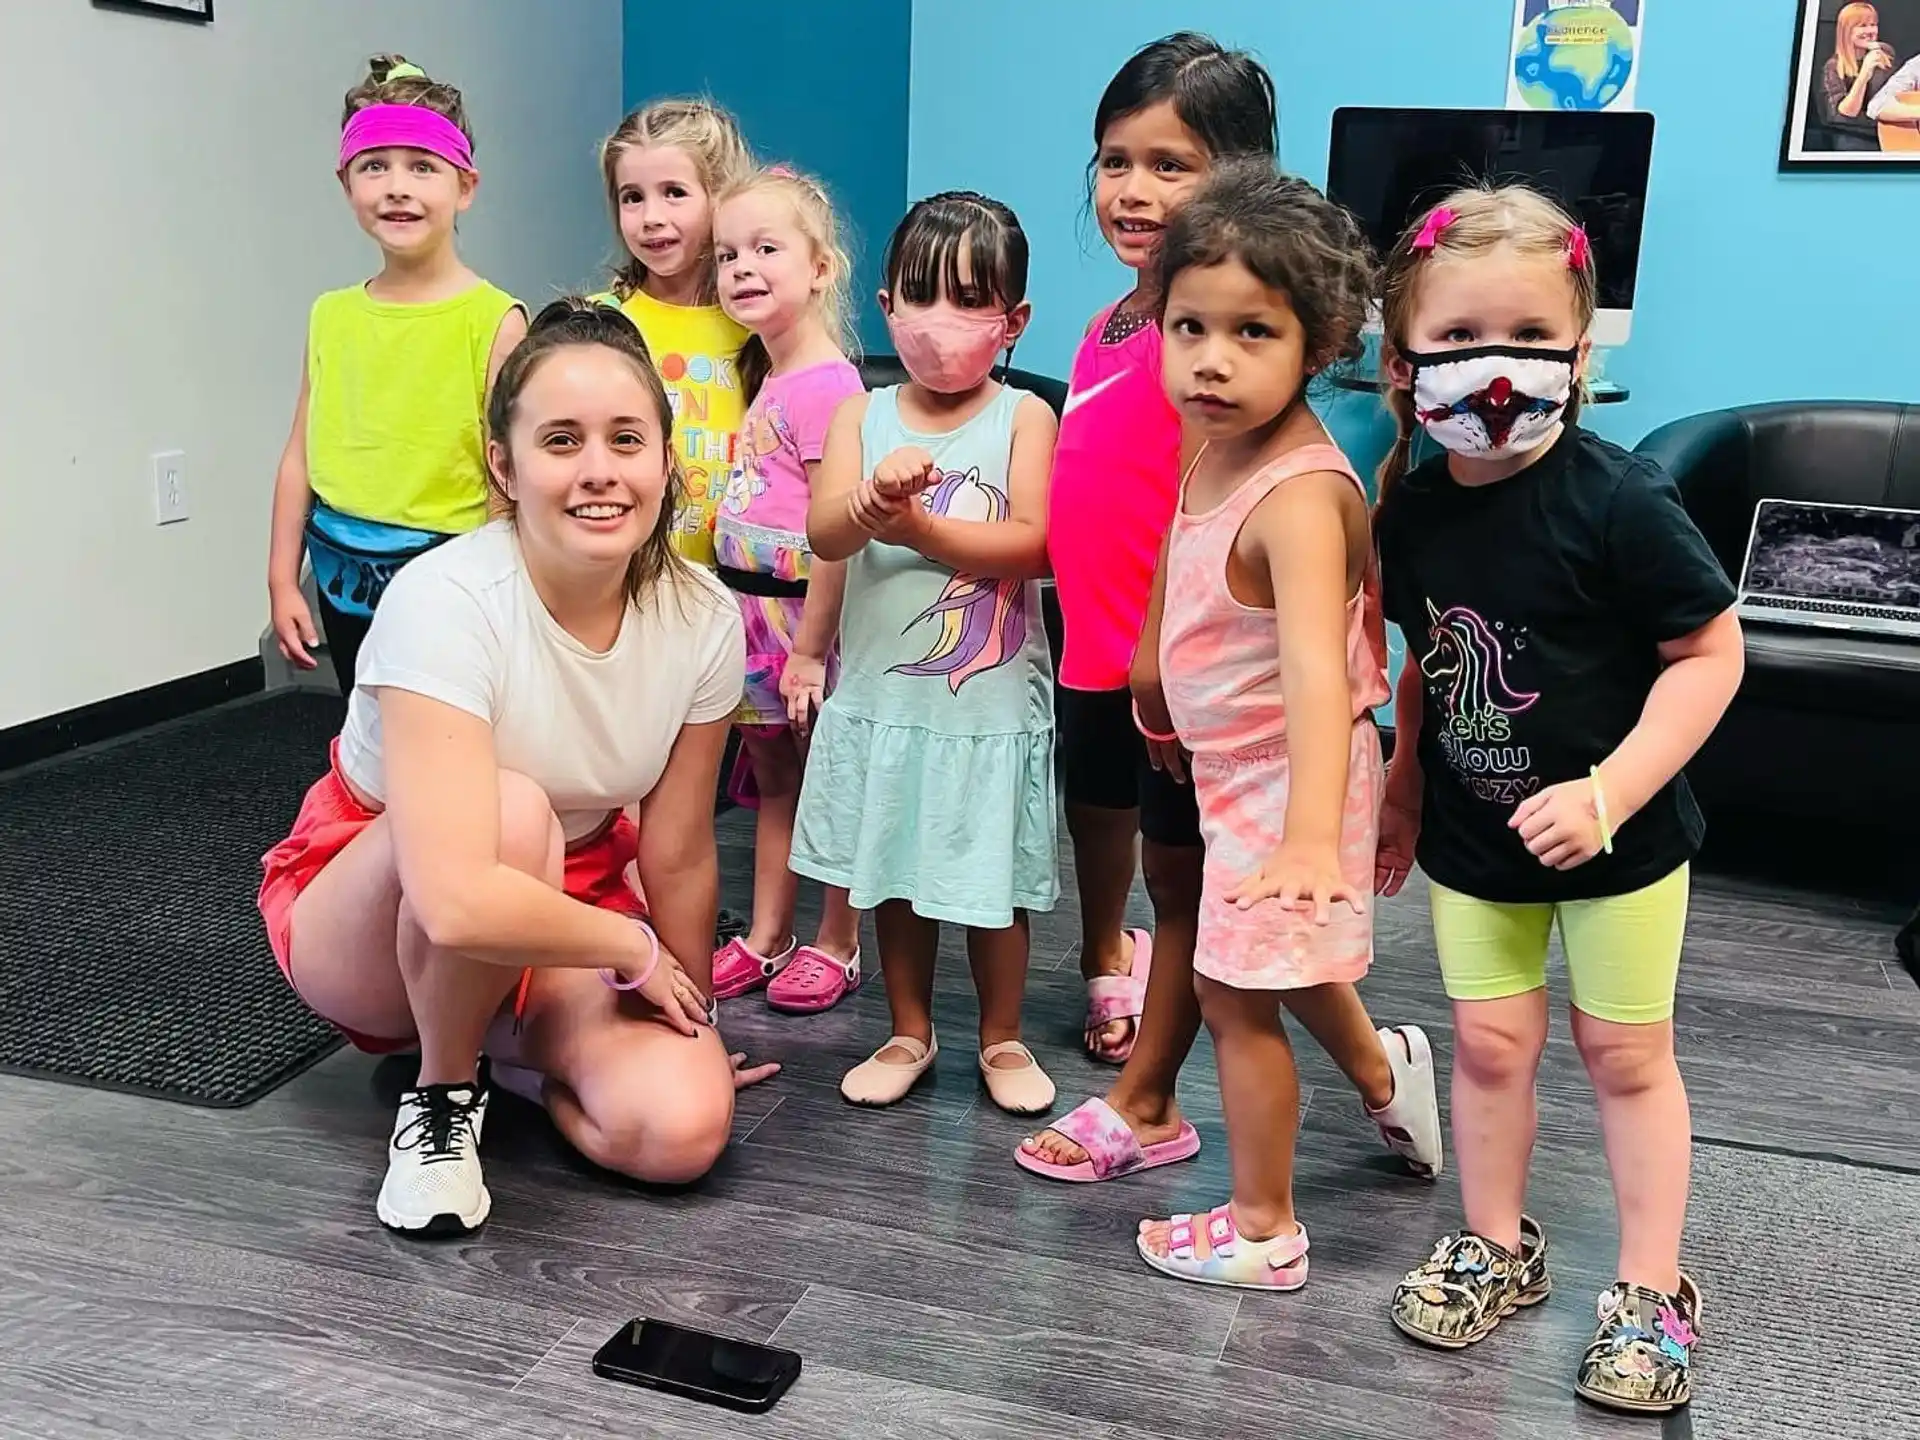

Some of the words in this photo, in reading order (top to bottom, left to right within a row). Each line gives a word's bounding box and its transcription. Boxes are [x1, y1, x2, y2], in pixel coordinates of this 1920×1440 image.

[661, 353, 735, 391] OOK
[1449, 701, 1511, 742] et's
[1440, 732, 1531, 773] low
